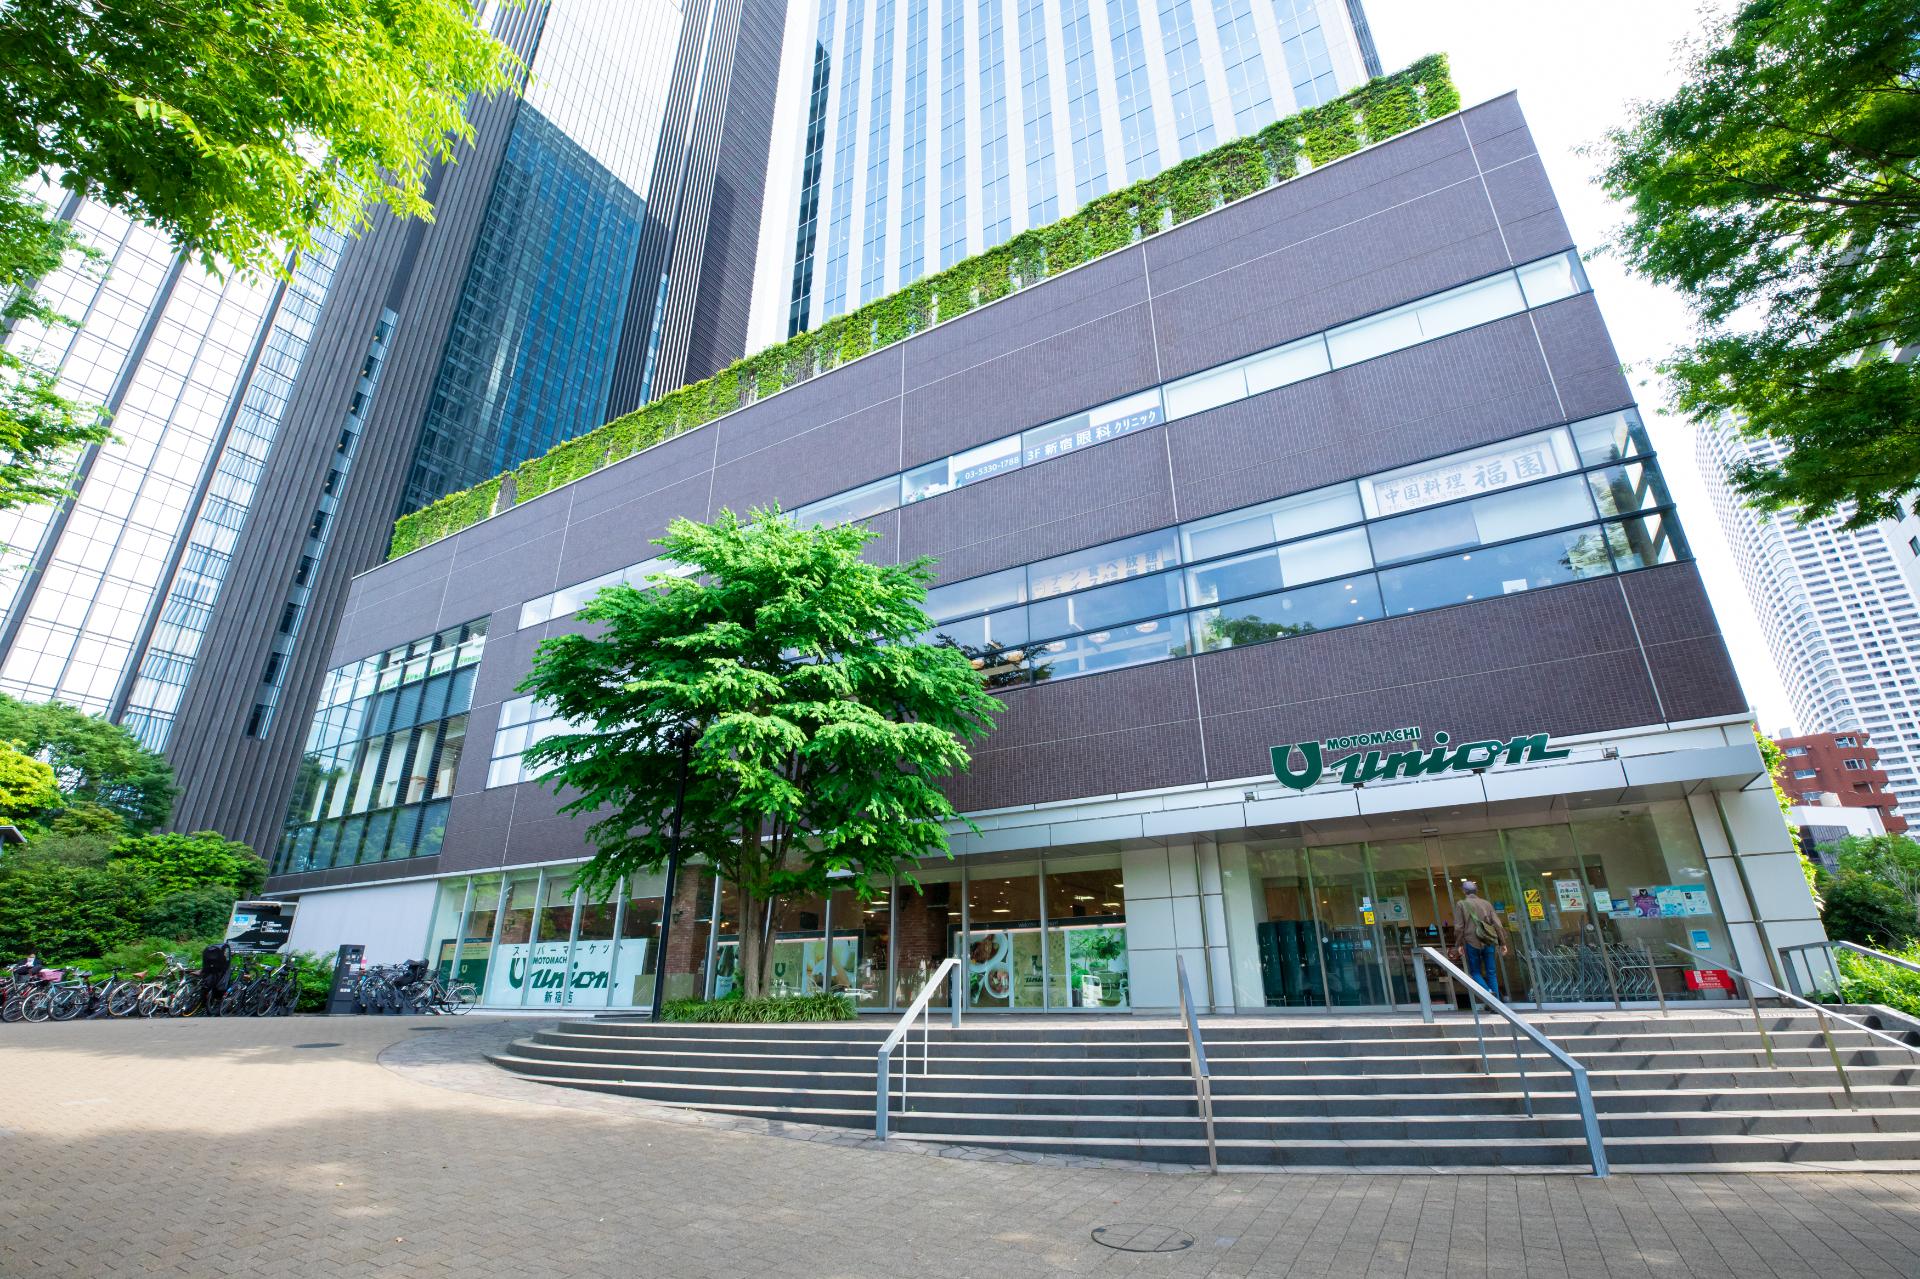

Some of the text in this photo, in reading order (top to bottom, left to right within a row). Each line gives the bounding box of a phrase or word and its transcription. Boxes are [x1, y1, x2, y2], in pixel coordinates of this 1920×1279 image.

[1027, 449, 1041, 461] 3F
[1384, 473, 1465, 506] 中国料理
[1472, 451, 1547, 489] 福園
[1326, 726, 1421, 751] MOTOMACHI
[1329, 731, 1572, 785] union
[532, 956, 568, 965] MOTOMACH
